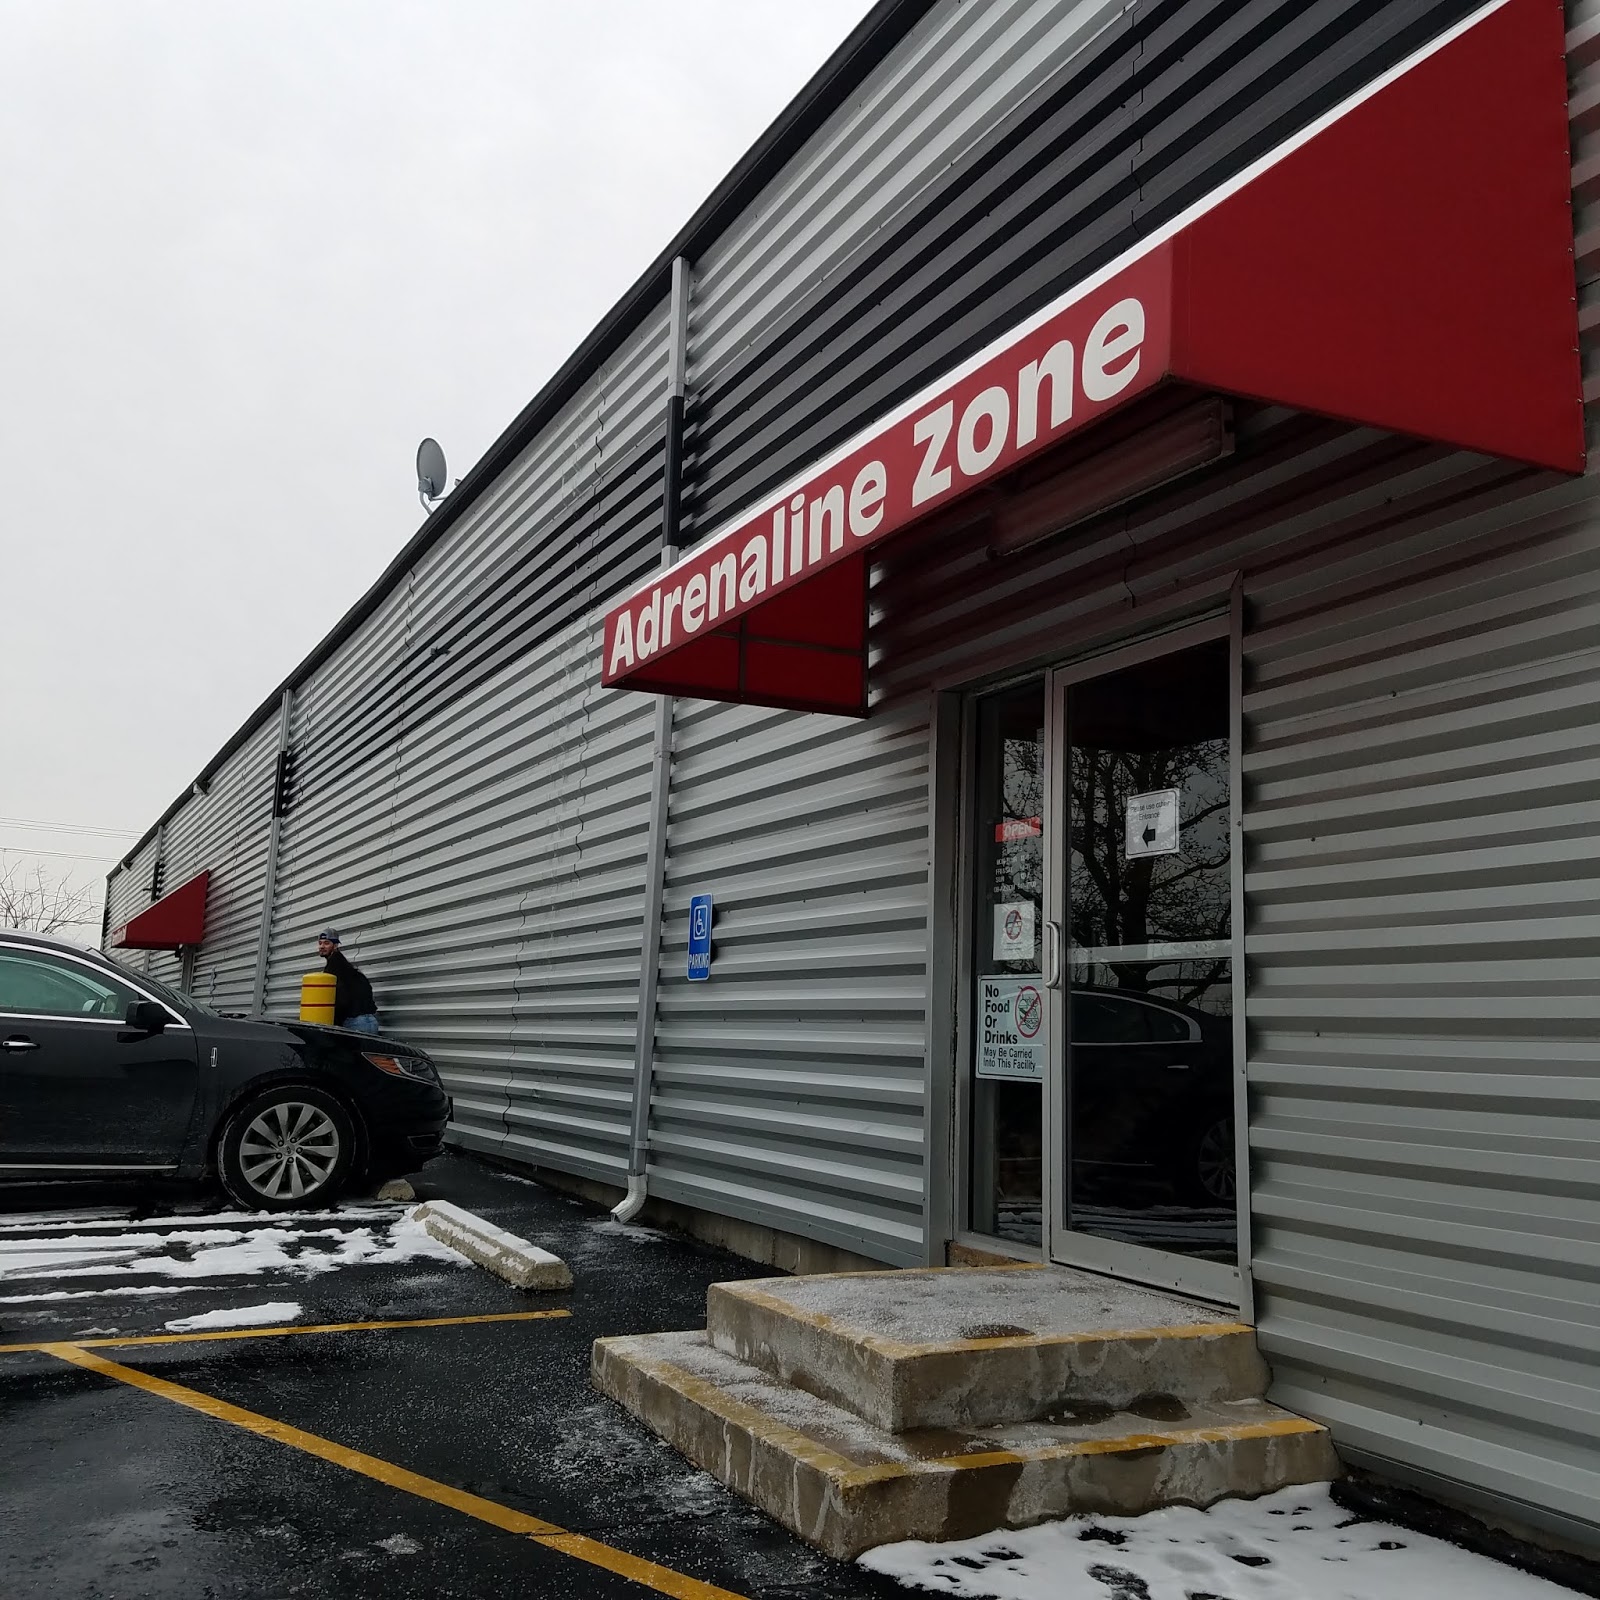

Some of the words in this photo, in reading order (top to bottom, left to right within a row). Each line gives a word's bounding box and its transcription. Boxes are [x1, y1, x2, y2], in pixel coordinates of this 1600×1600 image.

[608, 460, 887, 677] Adrenaline
[911, 297, 1146, 508] zone
[1004, 821, 1032, 837] OPEN
[689, 953, 709, 970] PARKING
[985, 984, 999, 998] No
[985, 1000, 1010, 1013] Food
[984, 1014, 998, 1028] Or
[984, 1031, 1018, 1044] Drinks
[984, 1047, 997, 1059] May
[998, 1048, 1008, 1056] Be
[1009, 1048, 1033, 1059] Carried
[984, 1058, 996, 1067] Into
[997, 1059, 1012, 1069] This
[1013, 1060, 1036, 1072] Facility
